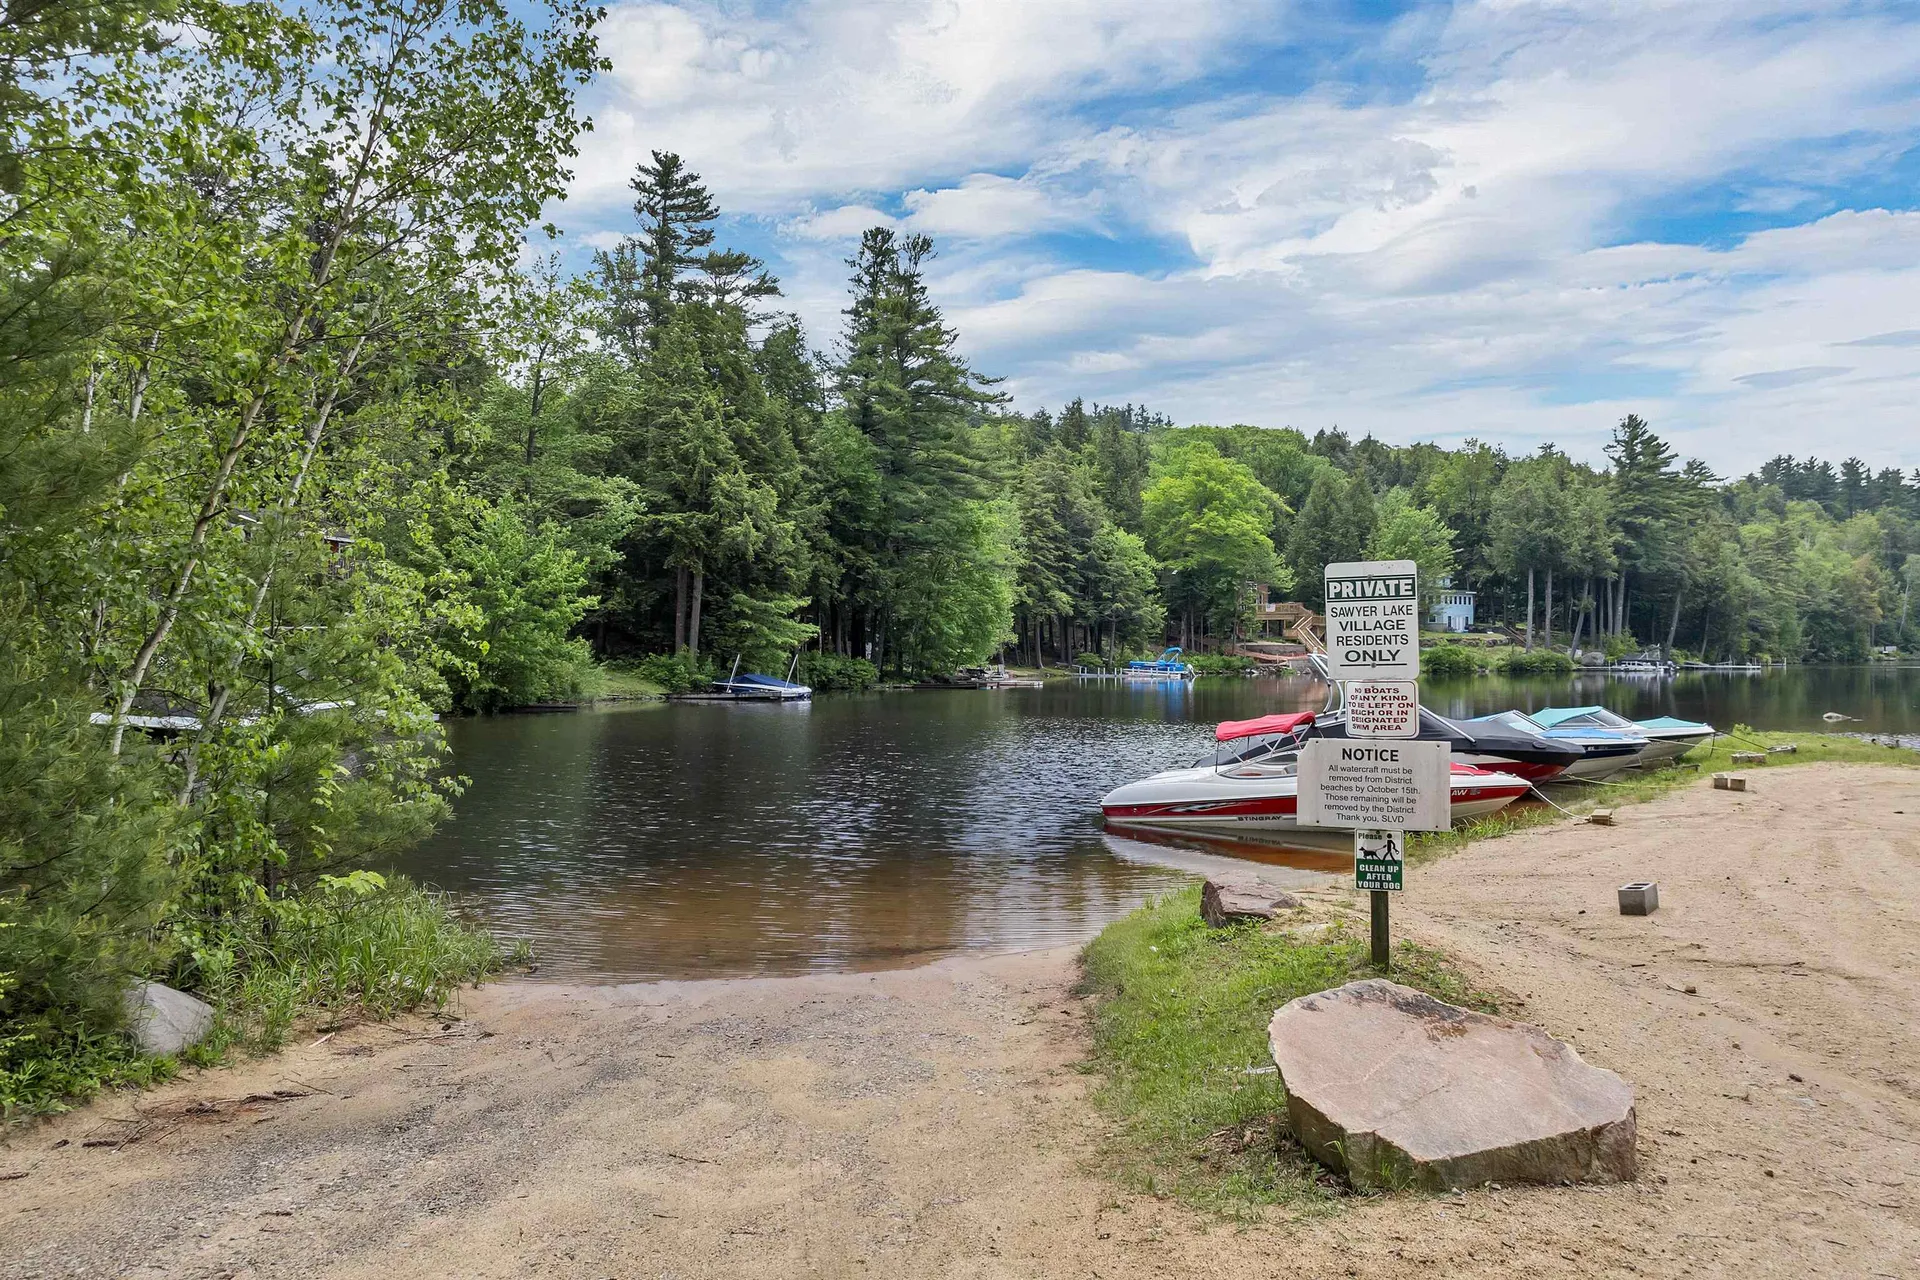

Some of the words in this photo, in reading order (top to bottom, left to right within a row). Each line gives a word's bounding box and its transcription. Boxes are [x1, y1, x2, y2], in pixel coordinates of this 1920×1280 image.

[1329, 579, 1413, 598] PRIVATE
[1331, 606, 1377, 617] SAWYER
[1383, 605, 1413, 616] LAKE
[1339, 620, 1405, 631] VILLAGE
[1337, 634, 1409, 646] RESIDENTS
[1345, 650, 1400, 662] ONLY
[1342, 748, 1399, 762] NOTICE
[1385, 776, 1412, 784] District
[1356, 785, 1365, 793] by
[1367, 785, 1398, 793] October
[1325, 793, 1348, 801] Those
[1351, 795, 1389, 804] remaining
[1361, 805, 1370, 813] by
